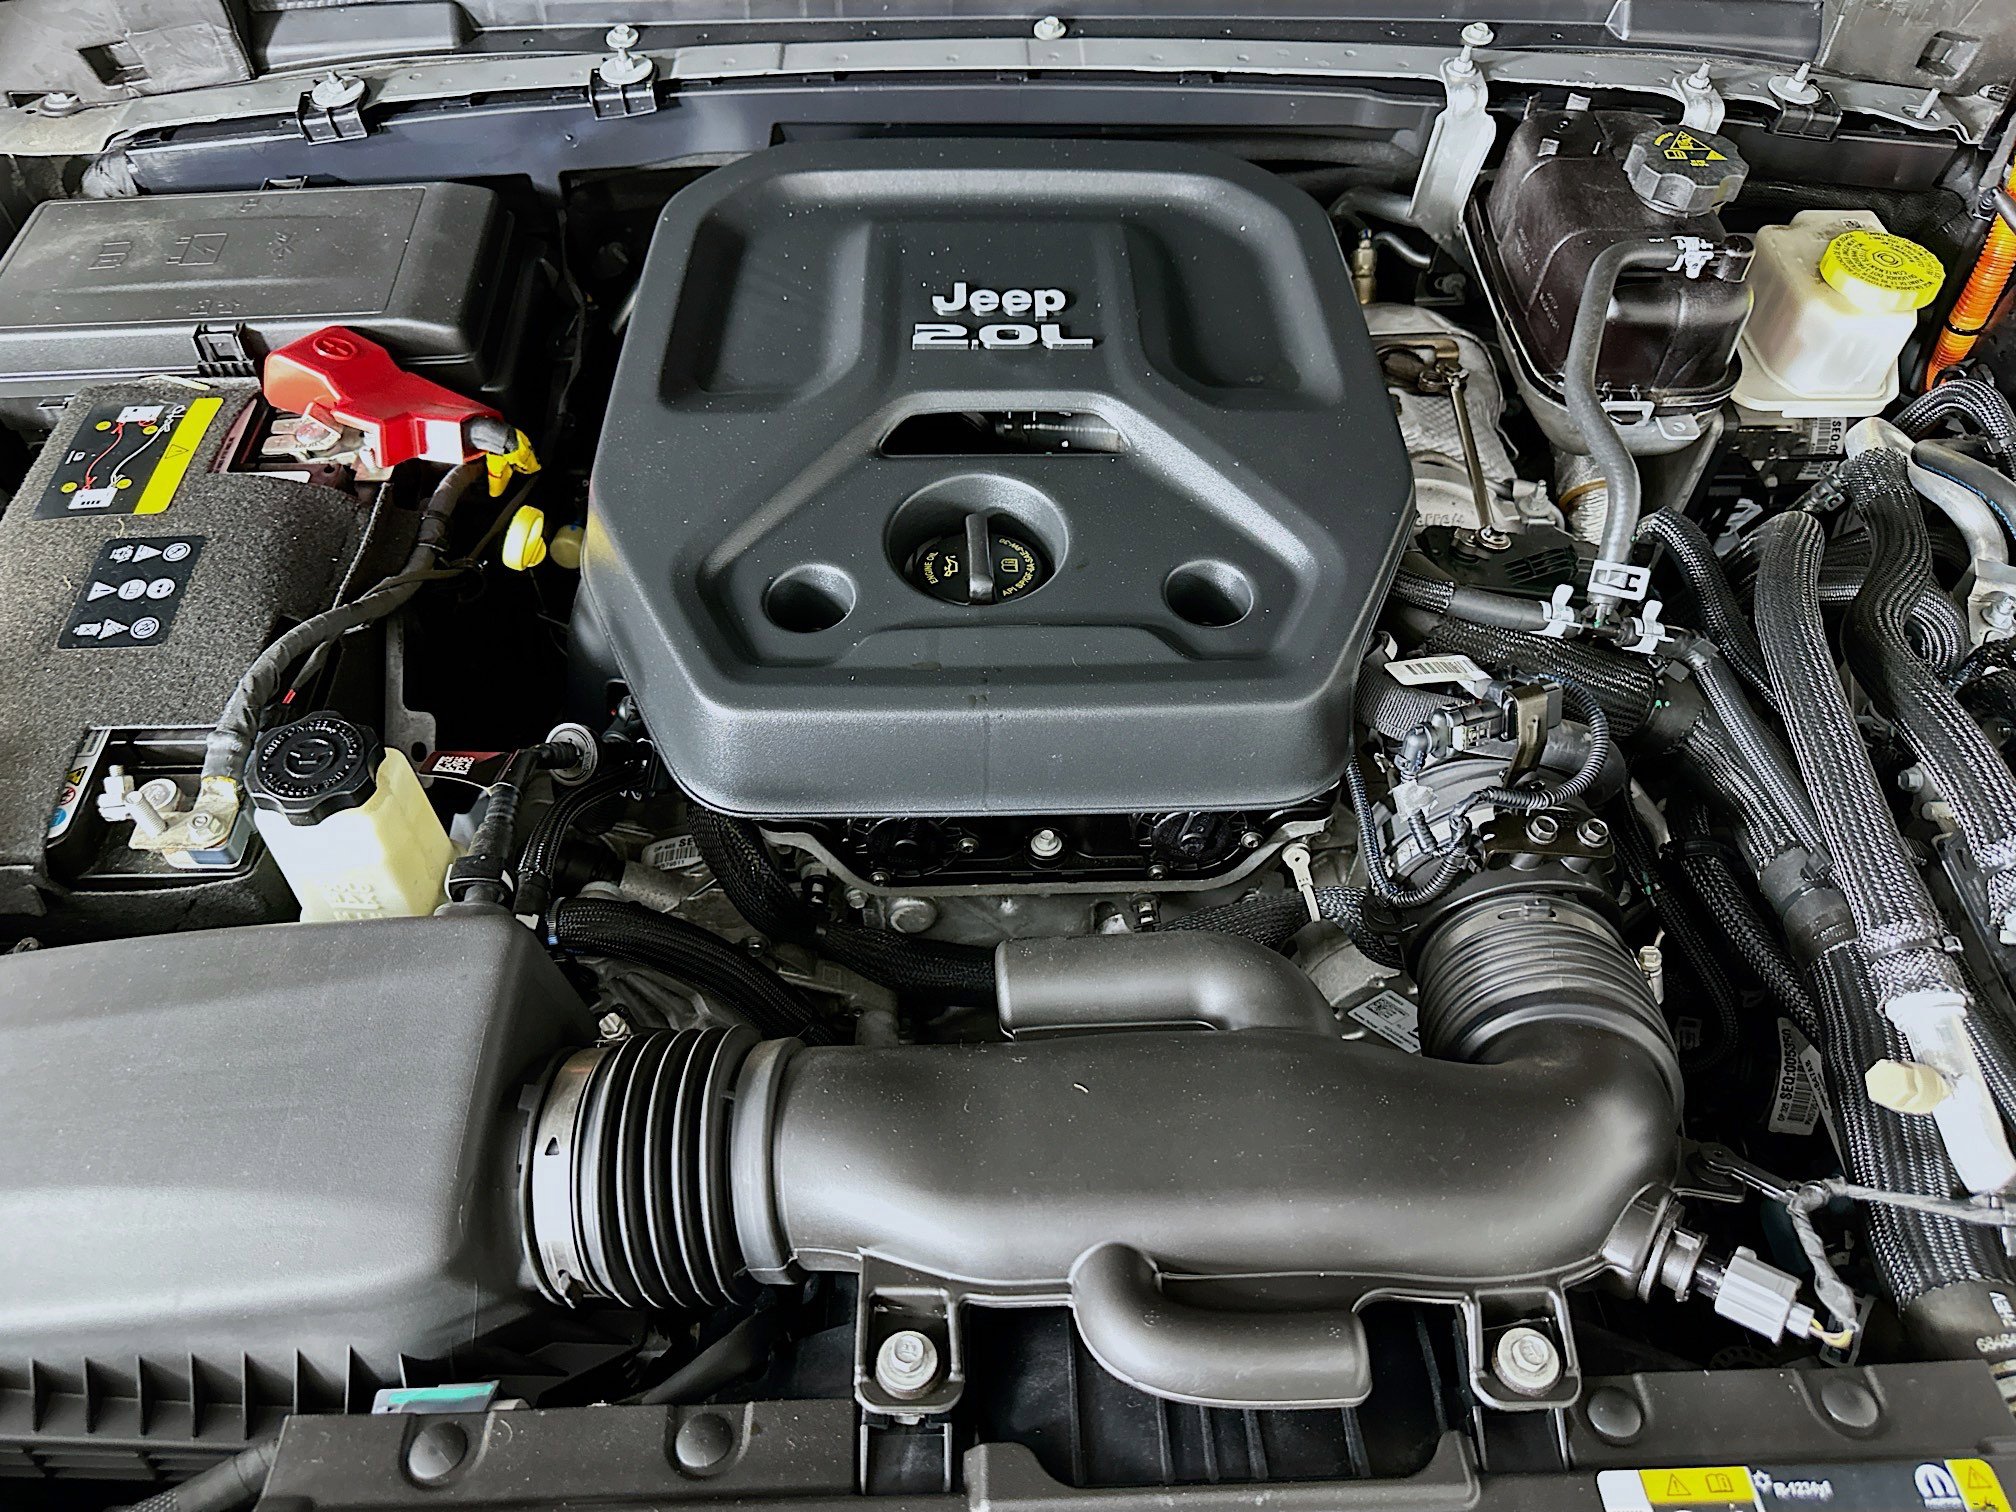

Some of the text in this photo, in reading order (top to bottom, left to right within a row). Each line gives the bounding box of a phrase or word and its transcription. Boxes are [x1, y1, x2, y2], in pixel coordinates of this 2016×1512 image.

[932, 282, 1066, 322] Jeep
[912, 323, 1094, 350] 2.0L
[924, 562, 939, 584] ENGINE
